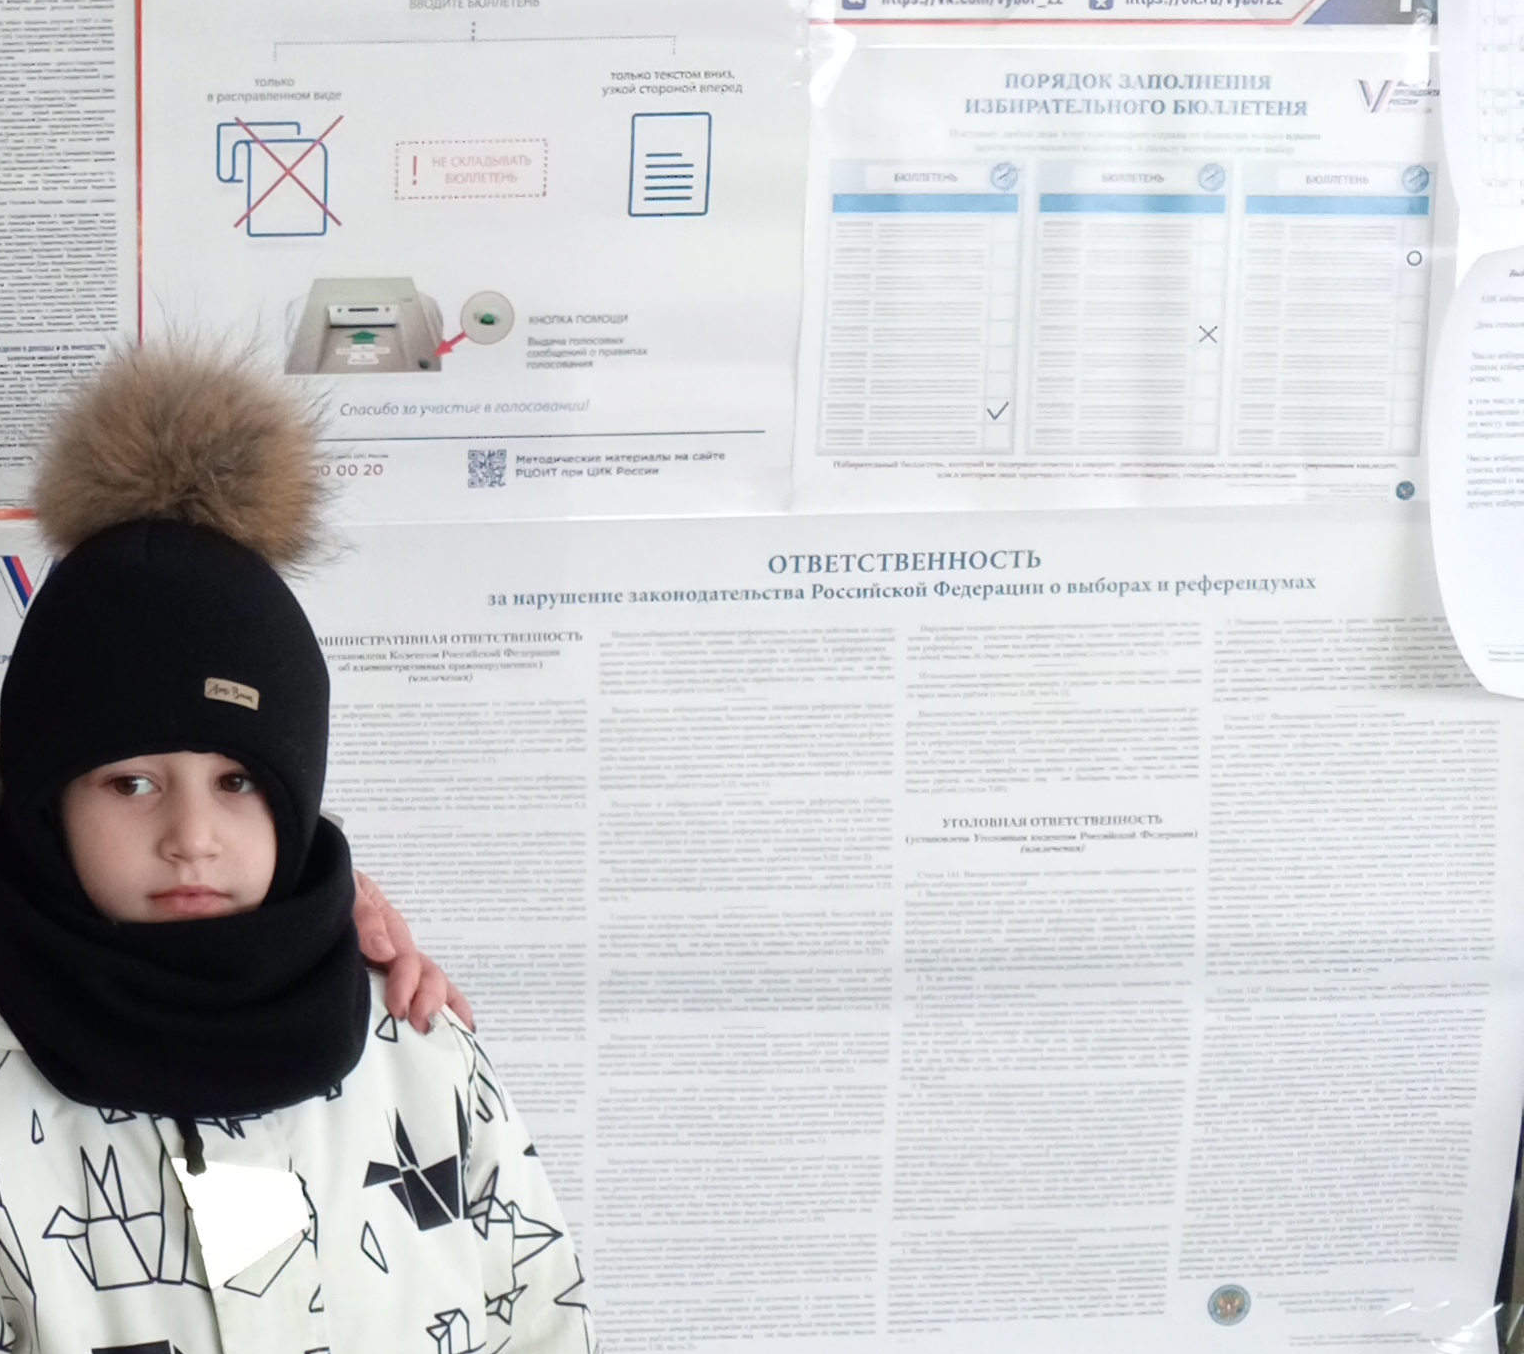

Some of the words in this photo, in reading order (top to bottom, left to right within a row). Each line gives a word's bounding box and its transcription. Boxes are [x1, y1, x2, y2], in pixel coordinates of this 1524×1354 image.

[1005, 73, 1112, 92] ПОРЯДОК
[1118, 74, 1272, 92] ЗАПОЛНЕНИЯ
[965, 99, 1166, 116] ИЗБИРАТЕЛЬНОГО
[1173, 101, 1308, 117] БЮЛЛЕТЕНЯ
[451, 155, 531, 168] СКЛАДЫВАТЬ
[445, 173, 517, 184] БЮЛЛЕТЕНЬ
[529, 315, 573, 325] КНОПКА
[576, 314, 628, 324] ПОМОЩИ
[340, 402, 399, 417] Спасибо
[402, 405, 417, 415] за
[420, 405, 481, 417] участие
[484, 404, 492, 413] в
[494, 399, 590, 413] голосовании!
[516, 455, 602, 464] Методические
[692, 451, 726, 461] сайте
[336, 465, 358, 476] 00
[364, 464, 384, 475] 20
[516, 468, 557, 479] РЦОИТ
[587, 467, 613, 477] ЦИК
[617, 467, 659, 475] России
[768, 550, 1041, 574] ОТВЕТСТВЕННОСТЬ
[487, 593, 507, 607] за
[513, 589, 624, 610] нарушение
[628, 586, 805, 605] законодательства
[811, 582, 927, 600] Российской
[933, 581, 1044, 602] Федерации
[1050, 583, 1061, 595] о
[1067, 577, 1152, 597] выборах
[1158, 582, 1169, 593] и
[1175, 575, 1316, 597] референдумах
[316, 636, 448, 647] МИНИСТРАТИВНАЯ
